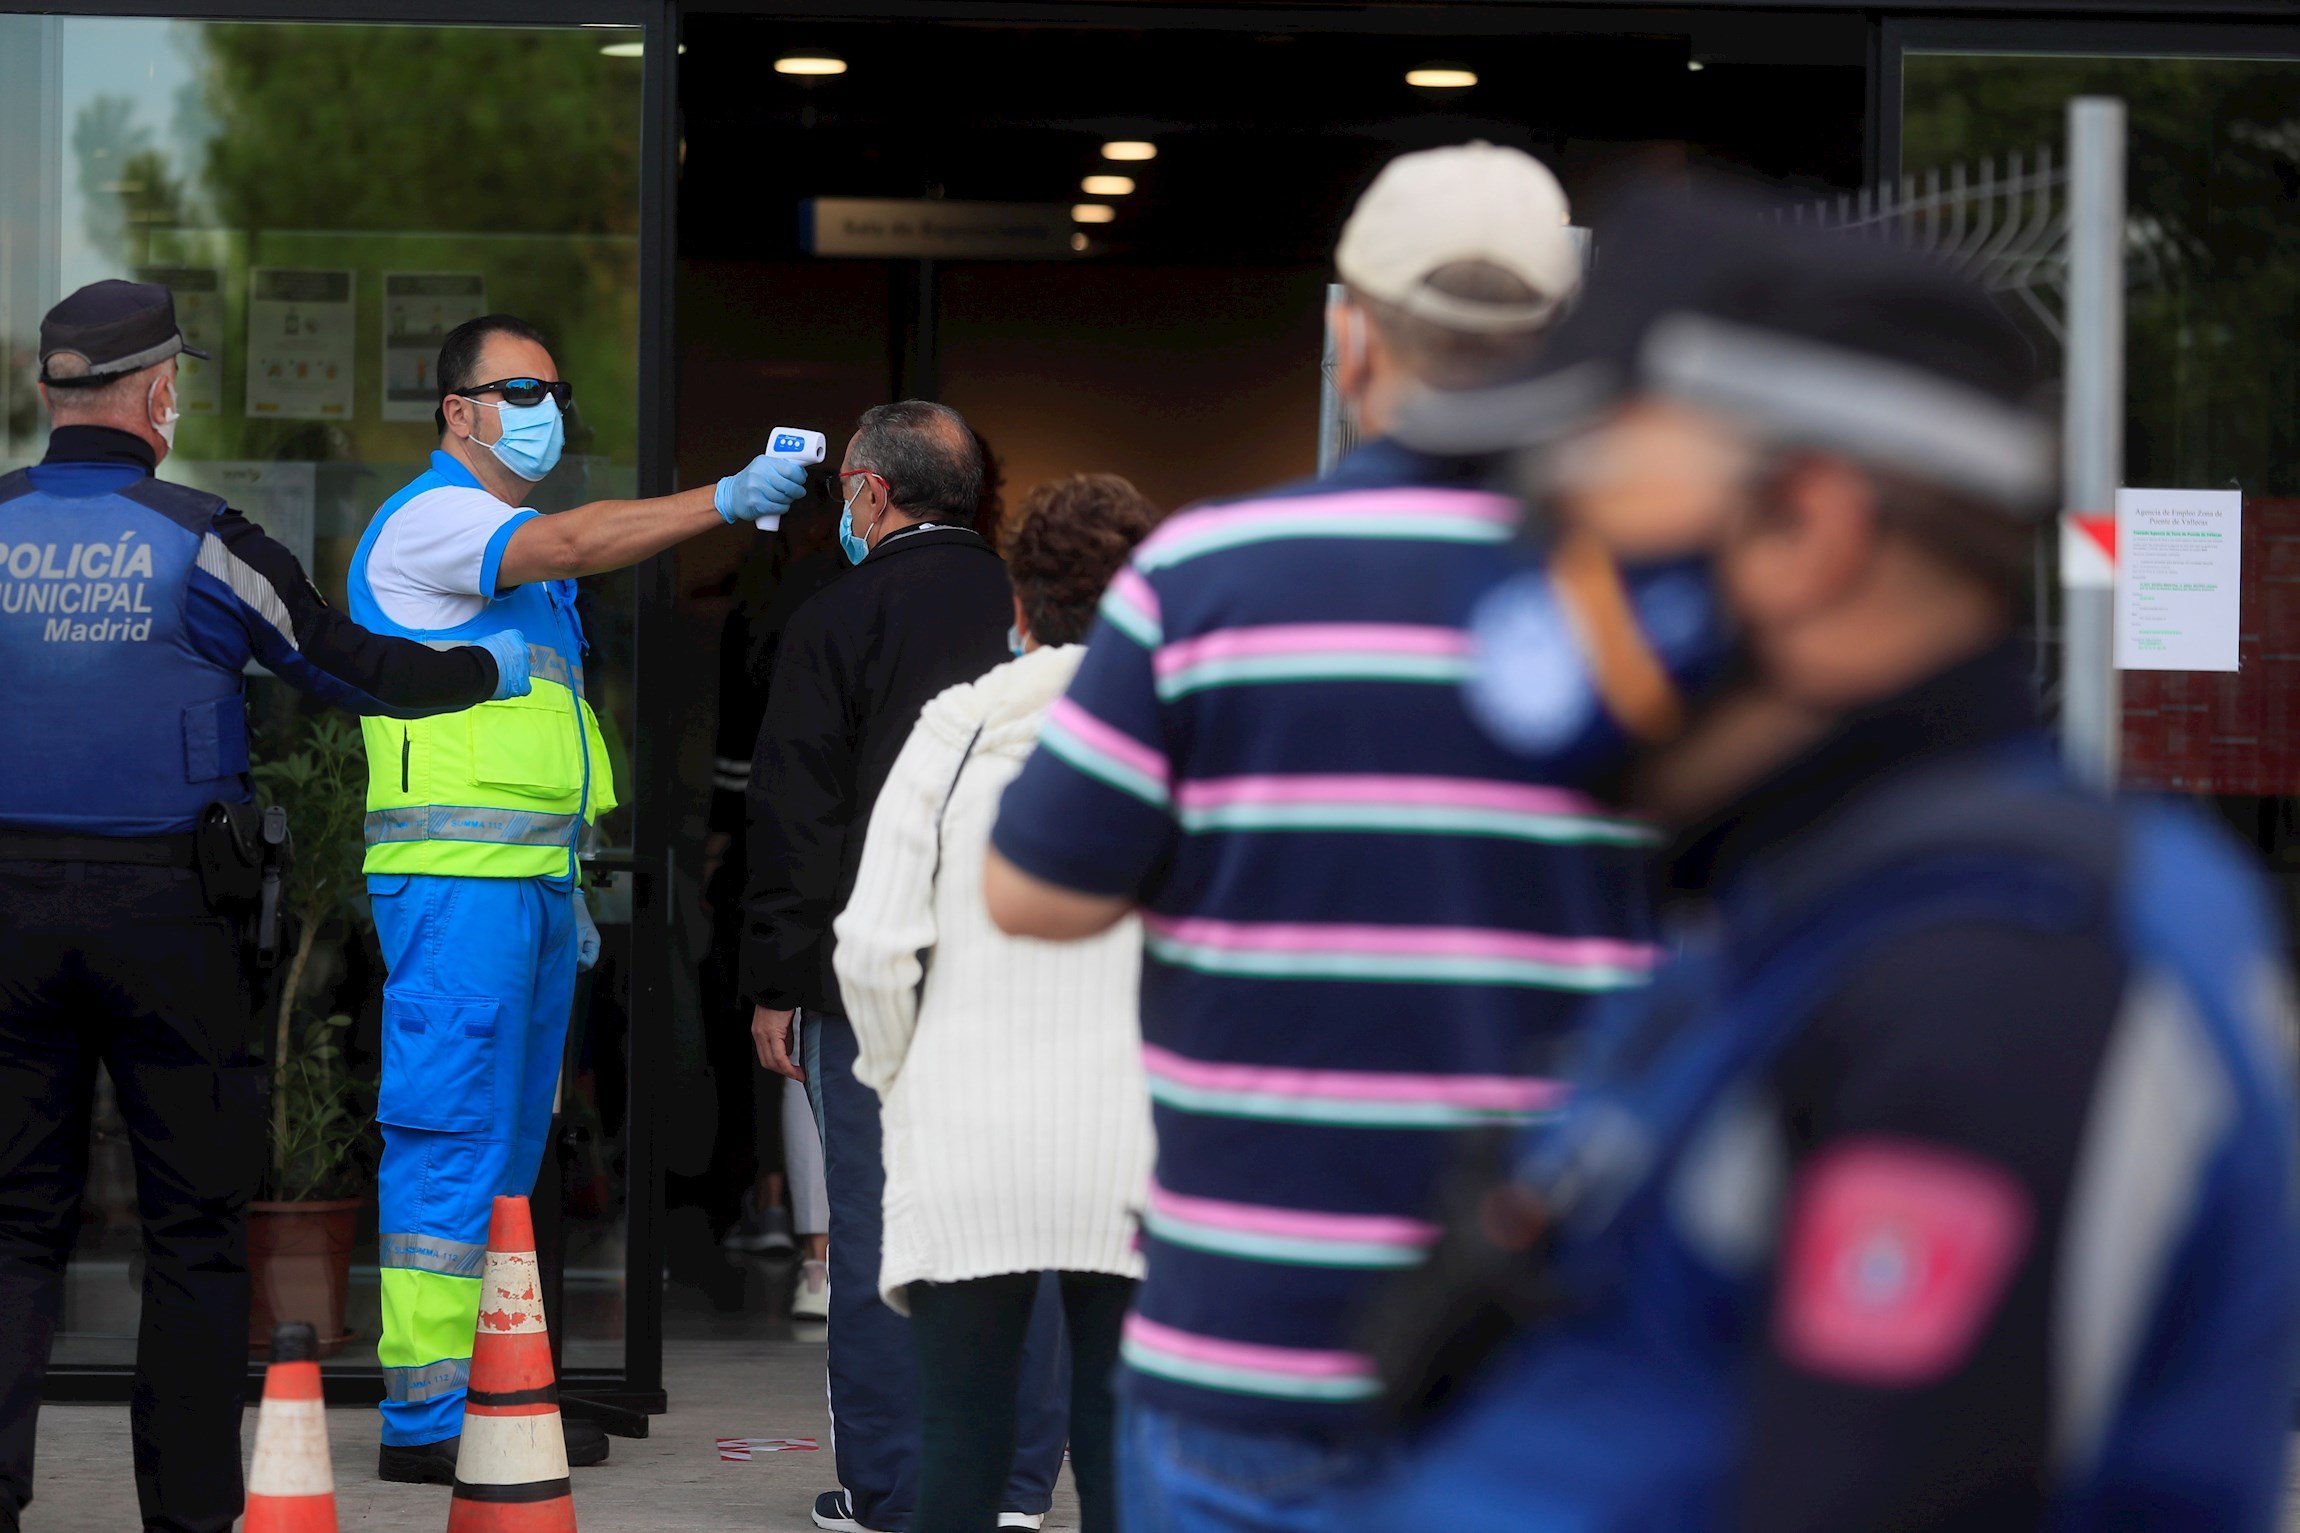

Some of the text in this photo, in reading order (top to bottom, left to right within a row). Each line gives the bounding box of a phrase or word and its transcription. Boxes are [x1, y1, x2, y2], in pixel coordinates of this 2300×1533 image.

[2135, 508, 2161, 518] Agencia
[2162, 508, 2170, 516] de
[2171, 508, 2197, 518] Empleo
[2214, 509, 2223, 517] de
[2149, 518, 2208, 527] Puente de Vallecas
[0, 582, 152, 614] UNICIPAL
[43, 618, 152, 642] Madrid
[451, 820, 503, 830] SUMMA 112
[443, 1252, 458, 1261] 112
[435, 1374, 449, 1383] 112
